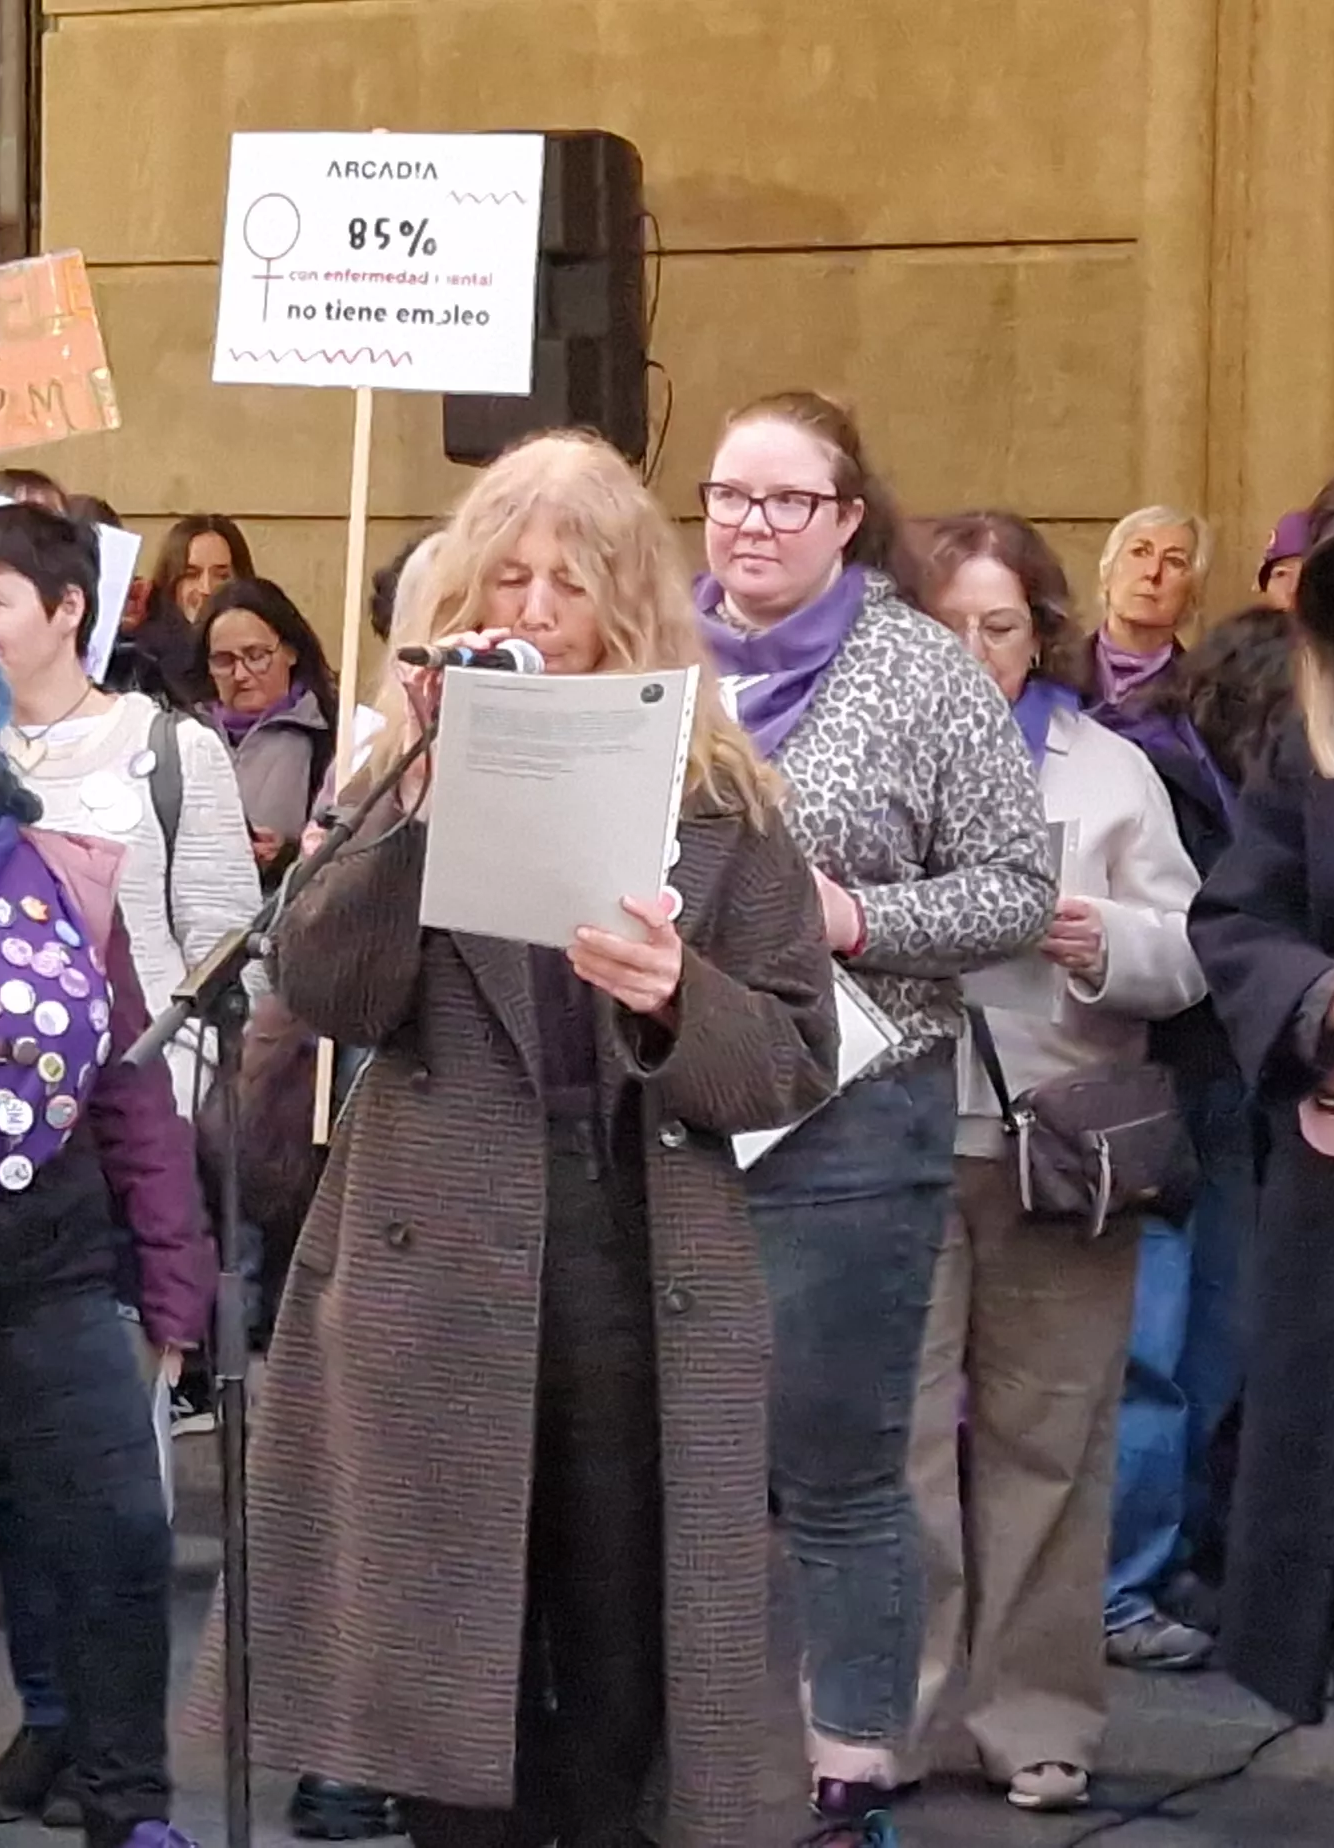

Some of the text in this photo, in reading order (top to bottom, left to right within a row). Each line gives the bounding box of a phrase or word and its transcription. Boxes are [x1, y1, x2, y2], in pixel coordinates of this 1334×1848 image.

[348, 217, 437, 258] 85%
[289, 270, 318, 281] con
[323, 268, 429, 286] enfermedad
[287, 302, 316, 320] no
[324, 299, 387, 322] tiene
